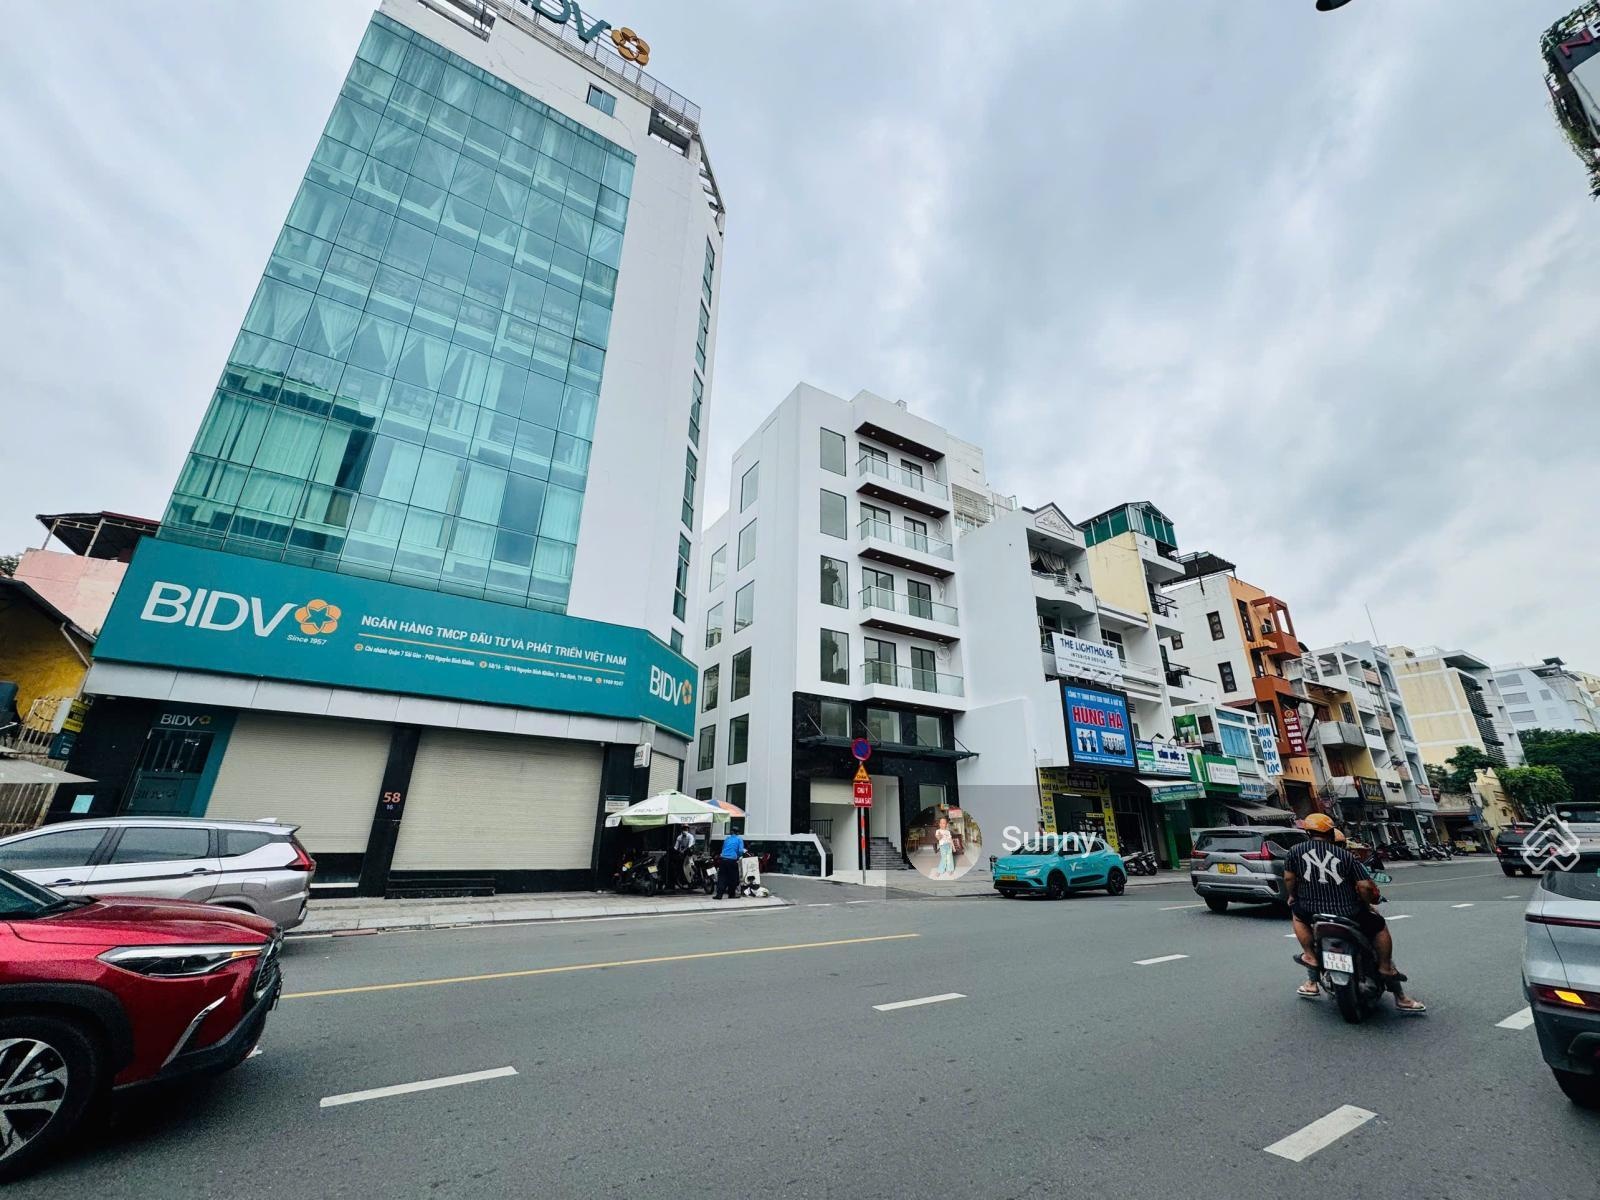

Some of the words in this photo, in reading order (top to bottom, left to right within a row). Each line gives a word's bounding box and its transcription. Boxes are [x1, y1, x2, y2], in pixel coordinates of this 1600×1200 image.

[140, 581, 298, 637] BIDV
[287, 634, 309, 643] Since
[309, 637, 328, 646] 1957
[361, 615, 398, 631] NGÂN
[399, 620, 434, 636] HÀNG
[436, 626, 468, 640] TMCP
[495, 636, 511, 647] TƯ
[511, 638, 525, 650] VÀ
[526, 641, 553, 654] PHÁT
[584, 650, 605, 663] VIỆT
[605, 654, 627, 666] NAM
[1060, 638, 1074, 649] THE
[1075, 641, 1114, 659] LIGHTHOUSE
[649, 665, 683, 706] BIDV
[160, 713, 199, 727] BIDV
[382, 792, 401, 803] 58
[1302, 848, 1345, 885] NY
